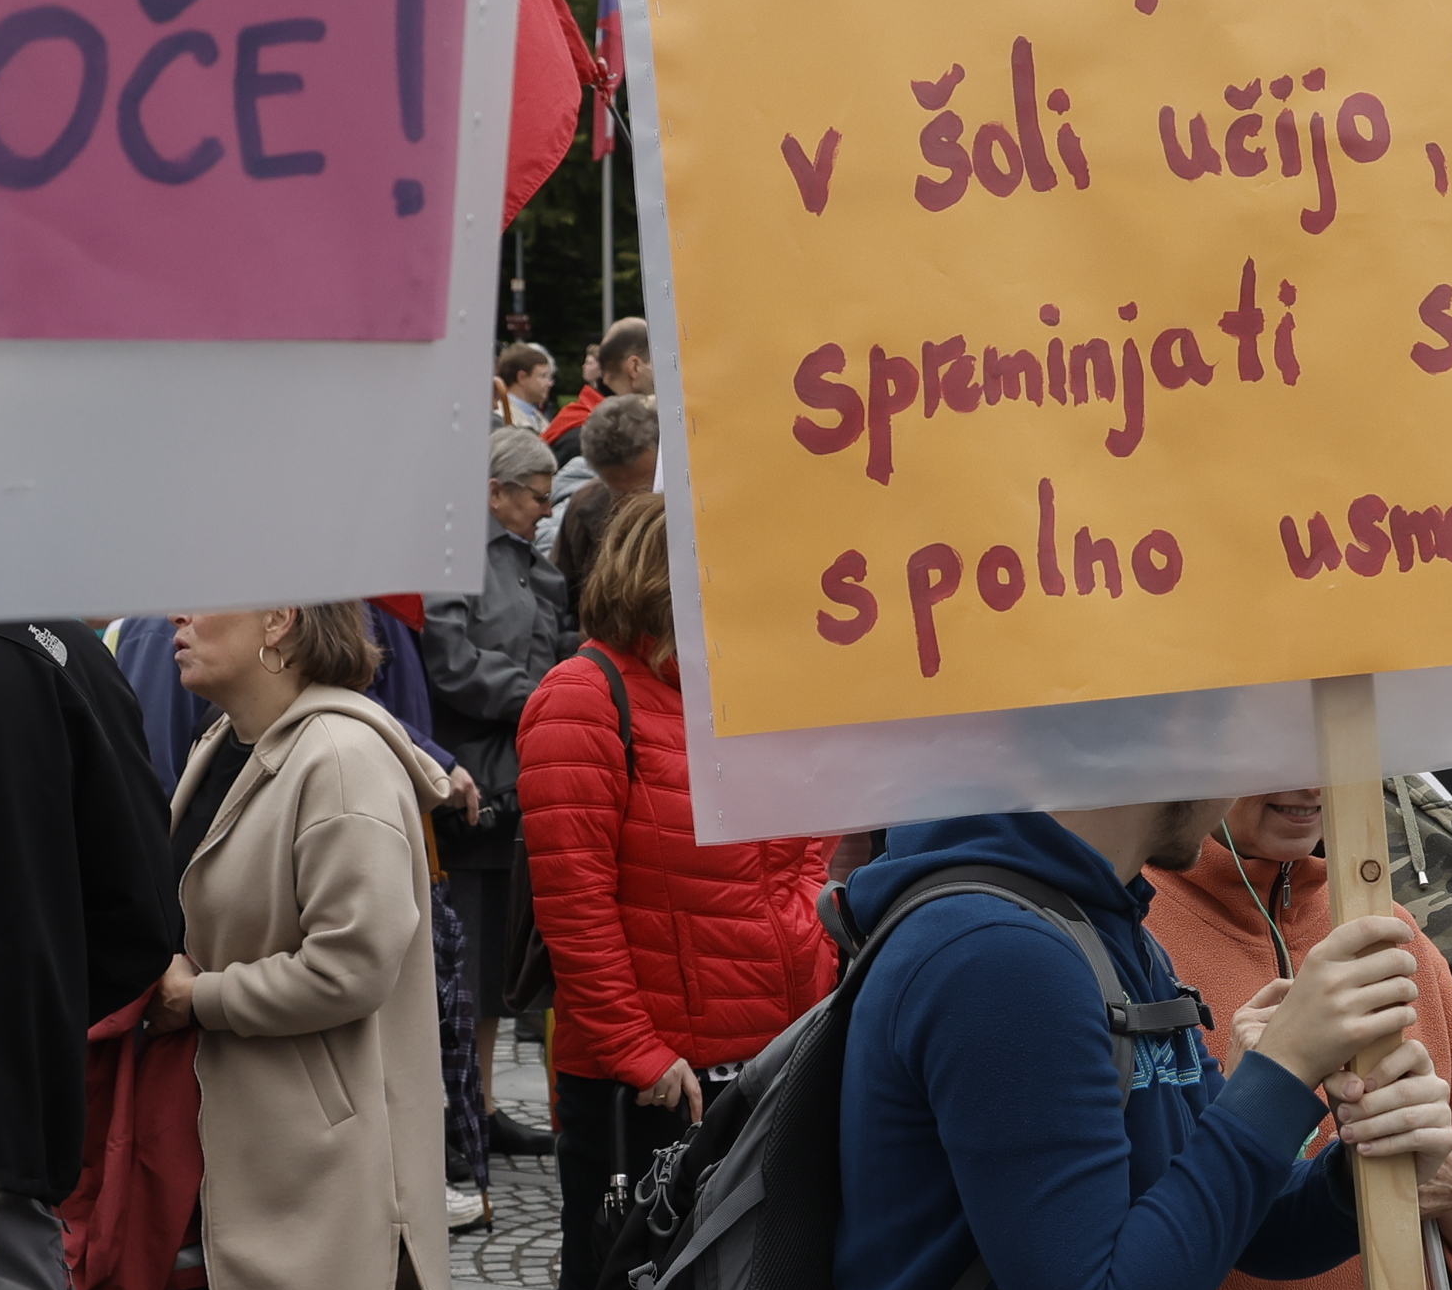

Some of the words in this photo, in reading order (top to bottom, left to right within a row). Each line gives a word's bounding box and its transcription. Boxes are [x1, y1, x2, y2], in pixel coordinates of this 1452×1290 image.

[780, 127, 841, 215] v
[912, 36, 1091, 212] šoli
[790, 257, 1299, 487] spreminjati
[816, 478, 1184, 678] spolno
